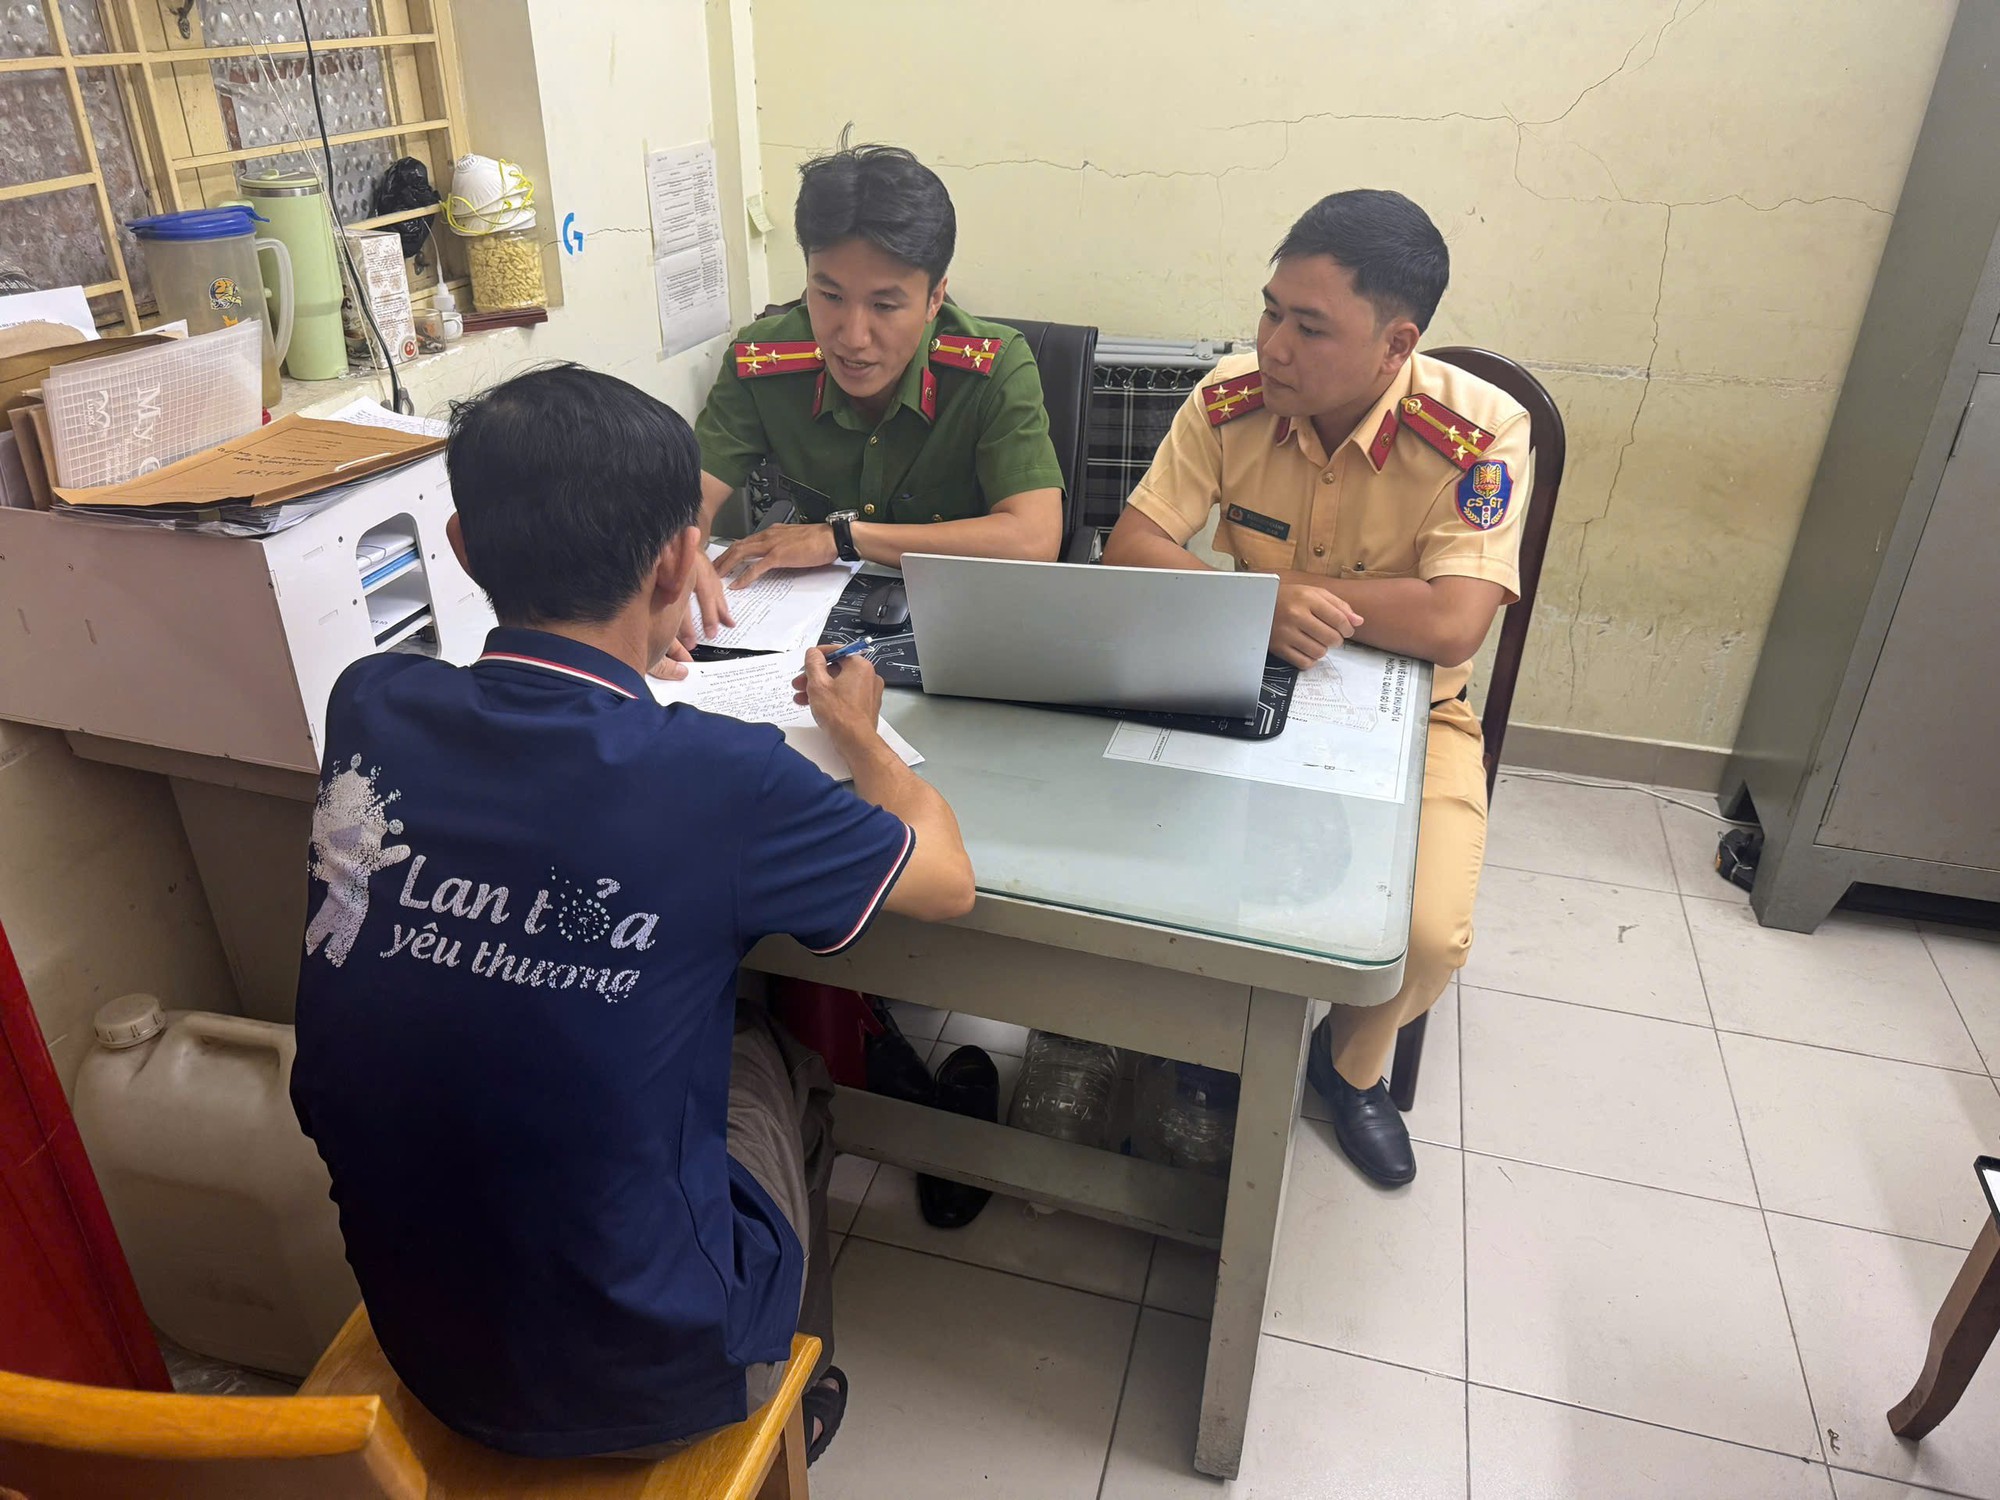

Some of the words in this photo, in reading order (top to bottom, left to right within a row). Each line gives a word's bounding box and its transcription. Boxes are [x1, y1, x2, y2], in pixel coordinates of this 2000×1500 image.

[86, 398, 96, 426] LUCKY
[133, 382, 161, 442] My
[1467, 497, 1483, 507] CS
[1489, 497, 1503, 508] GT
[399, 855, 511, 924] Lan
[524, 876, 660, 951] tỏa
[379, 922, 461, 967] yêu
